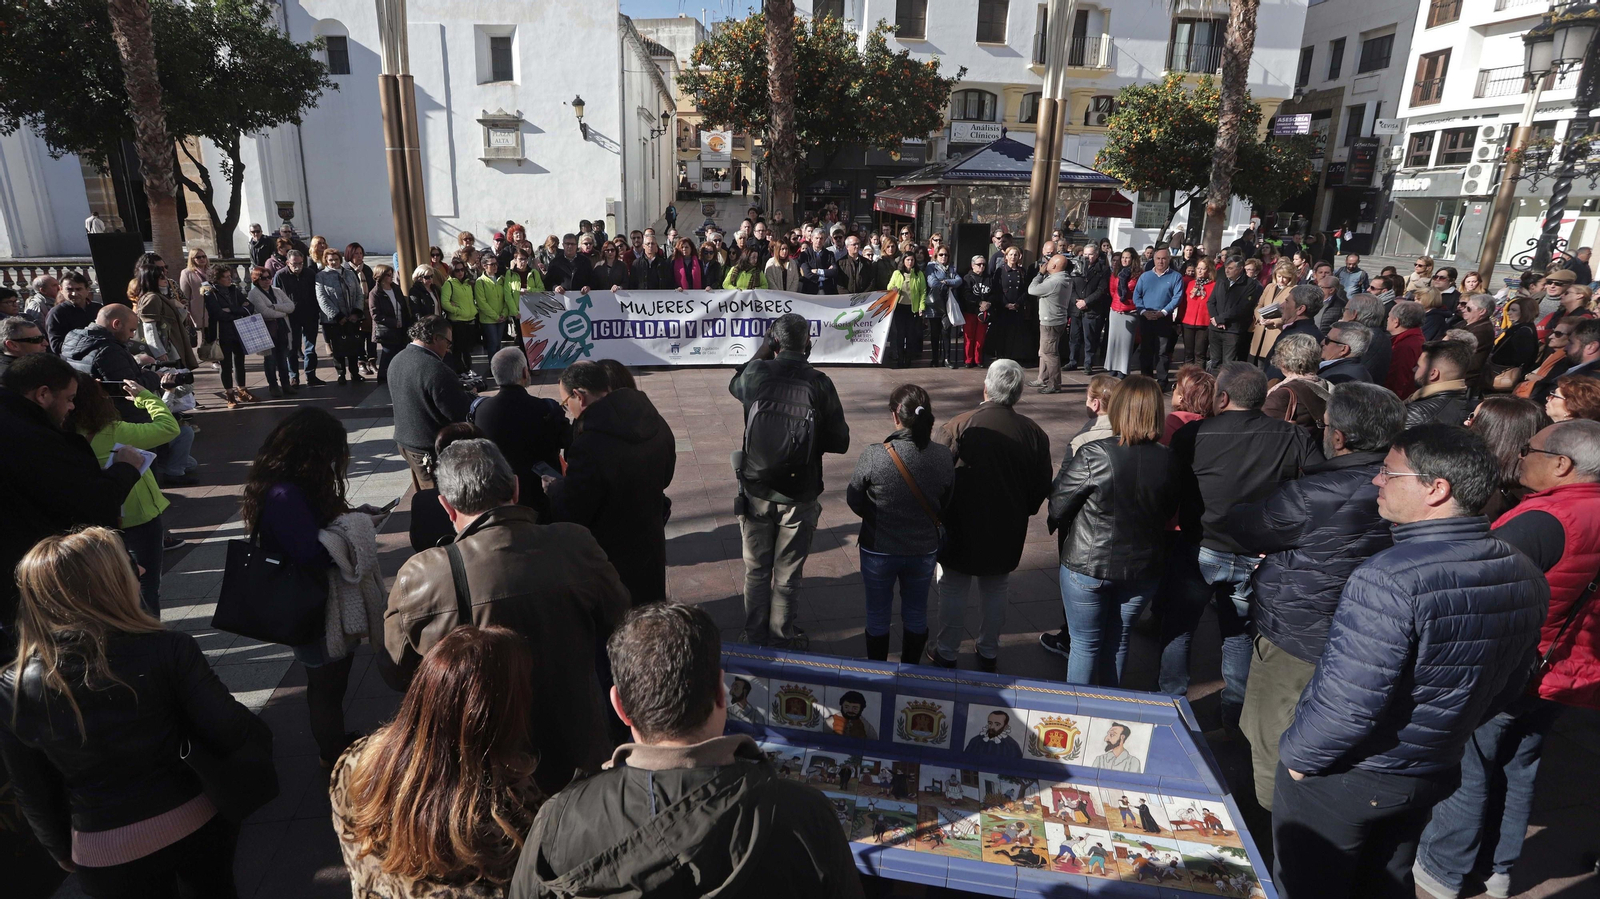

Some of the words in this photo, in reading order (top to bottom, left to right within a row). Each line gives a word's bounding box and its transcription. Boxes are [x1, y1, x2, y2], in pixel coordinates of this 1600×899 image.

[620, 300, 695, 317] MUJERES
[700, 300, 712, 314] Y
[718, 300, 793, 314] HOMBRES
[592, 320, 680, 338] IGUALDAD
[687, 321, 696, 337] Y
[703, 319, 725, 337] NO
[853, 320, 873, 328] Kent
